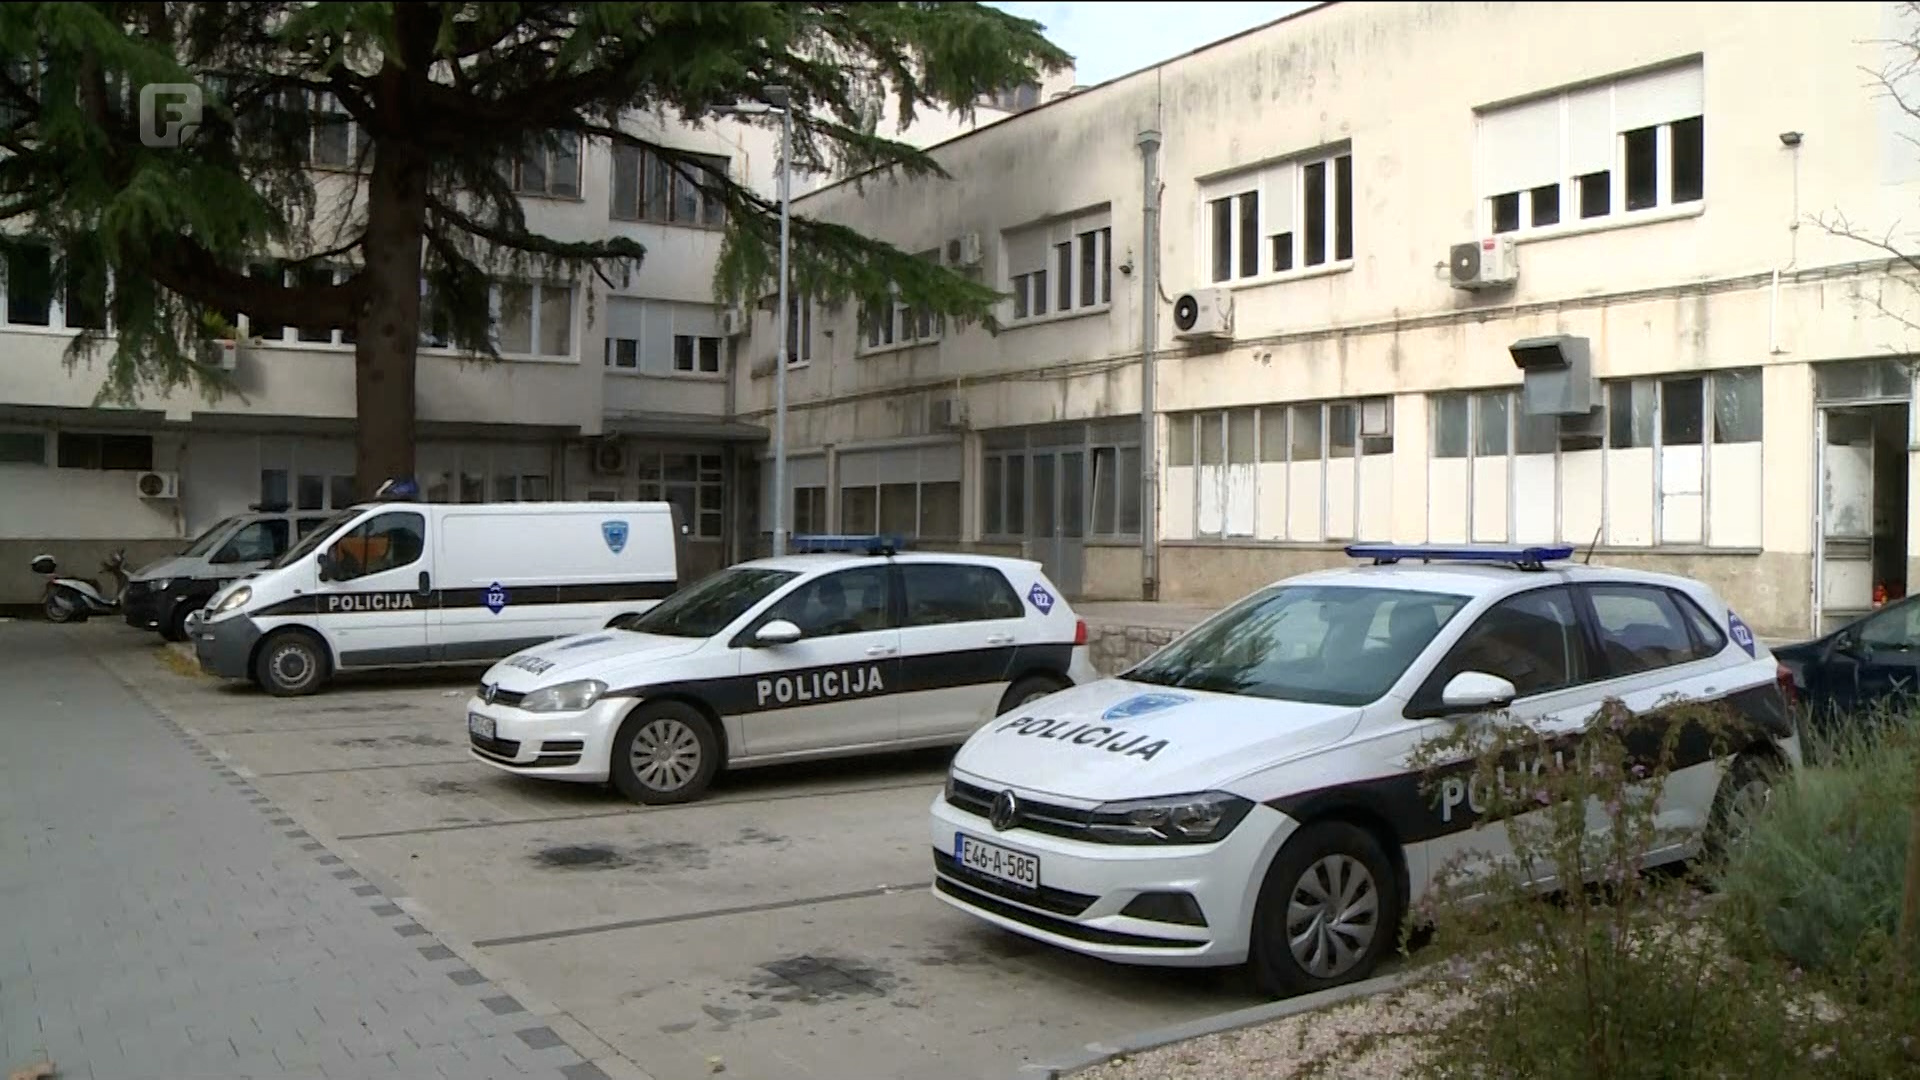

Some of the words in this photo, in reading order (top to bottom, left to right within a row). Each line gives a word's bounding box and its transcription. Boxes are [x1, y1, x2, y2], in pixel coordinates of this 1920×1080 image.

[329, 592, 414, 612] POLICIJA
[488, 593, 505, 606] 122
[1032, 593, 1051, 607] 122
[756, 666, 884, 706] POLICIJA
[996, 717, 1170, 762] POLICIJA
[964, 840, 1034, 882] E46-A-585
